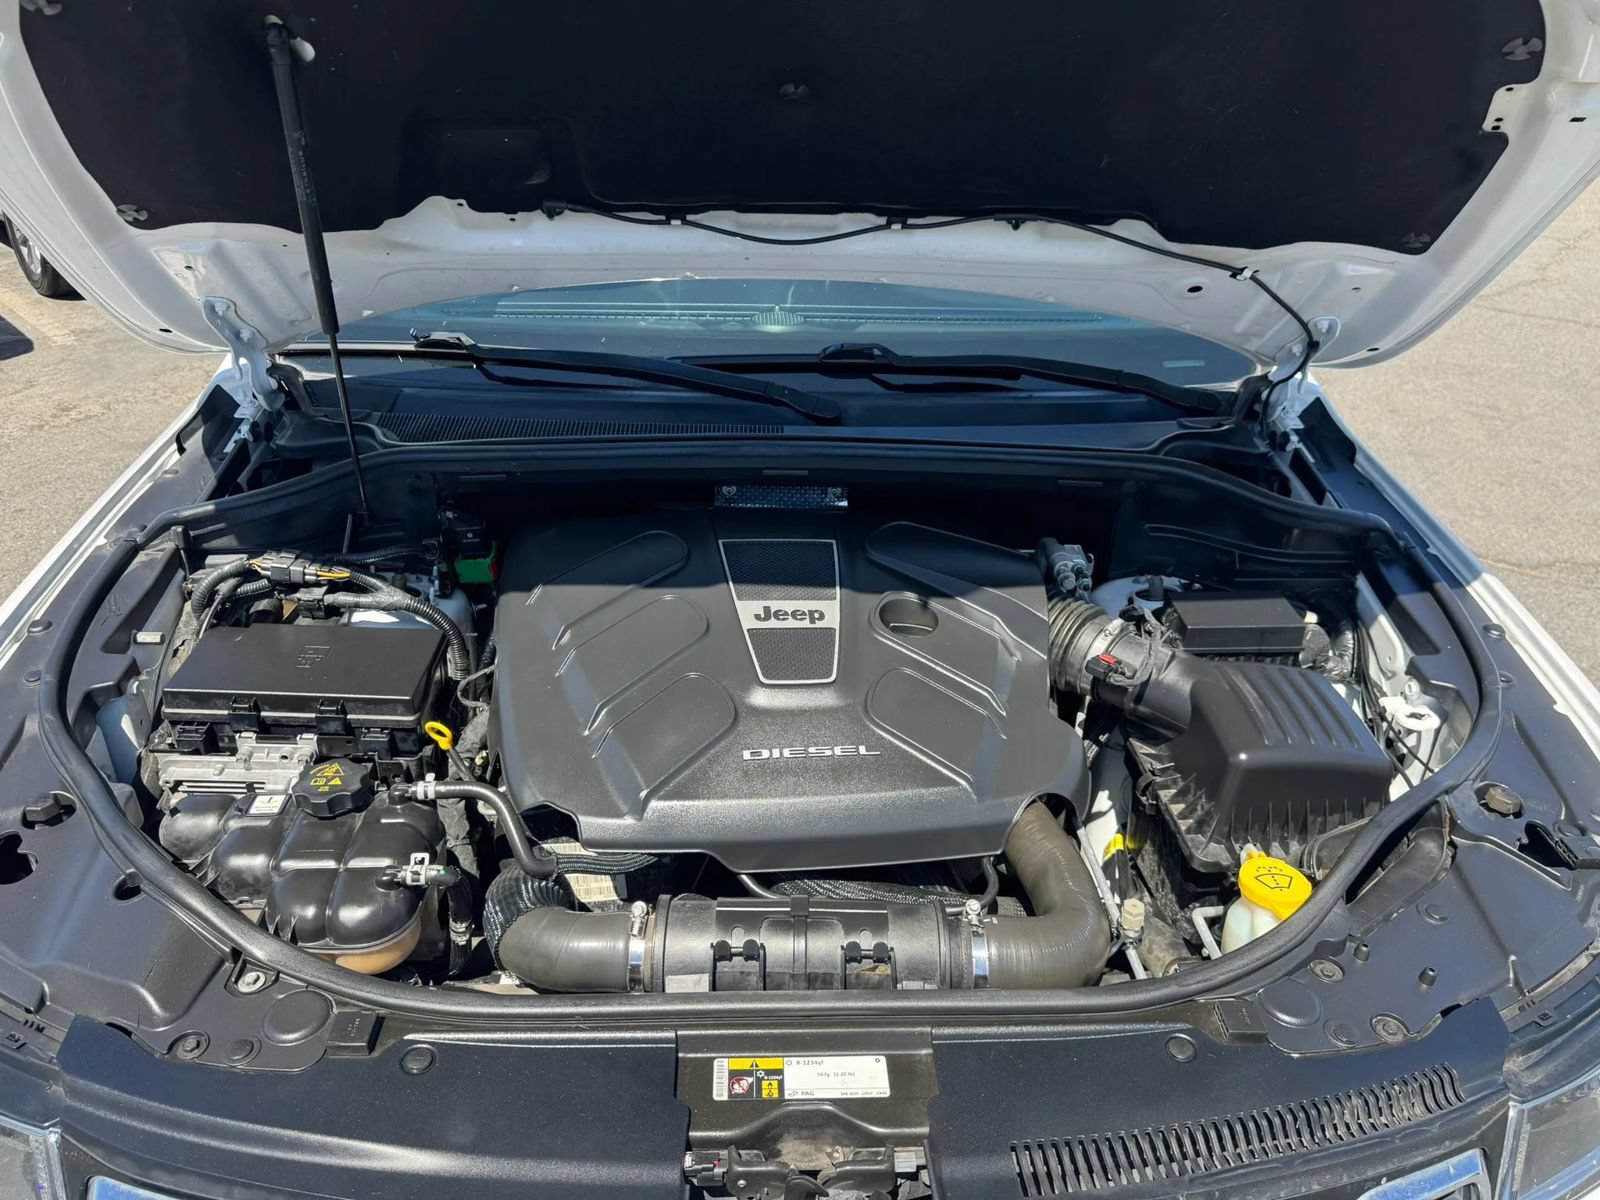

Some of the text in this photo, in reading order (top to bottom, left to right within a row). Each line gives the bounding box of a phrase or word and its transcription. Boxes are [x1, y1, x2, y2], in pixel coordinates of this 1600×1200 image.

[298, 151, 311, 194] STABILUS
[753, 606, 826, 625] Jeep
[742, 745, 881, 761] DIESEL
